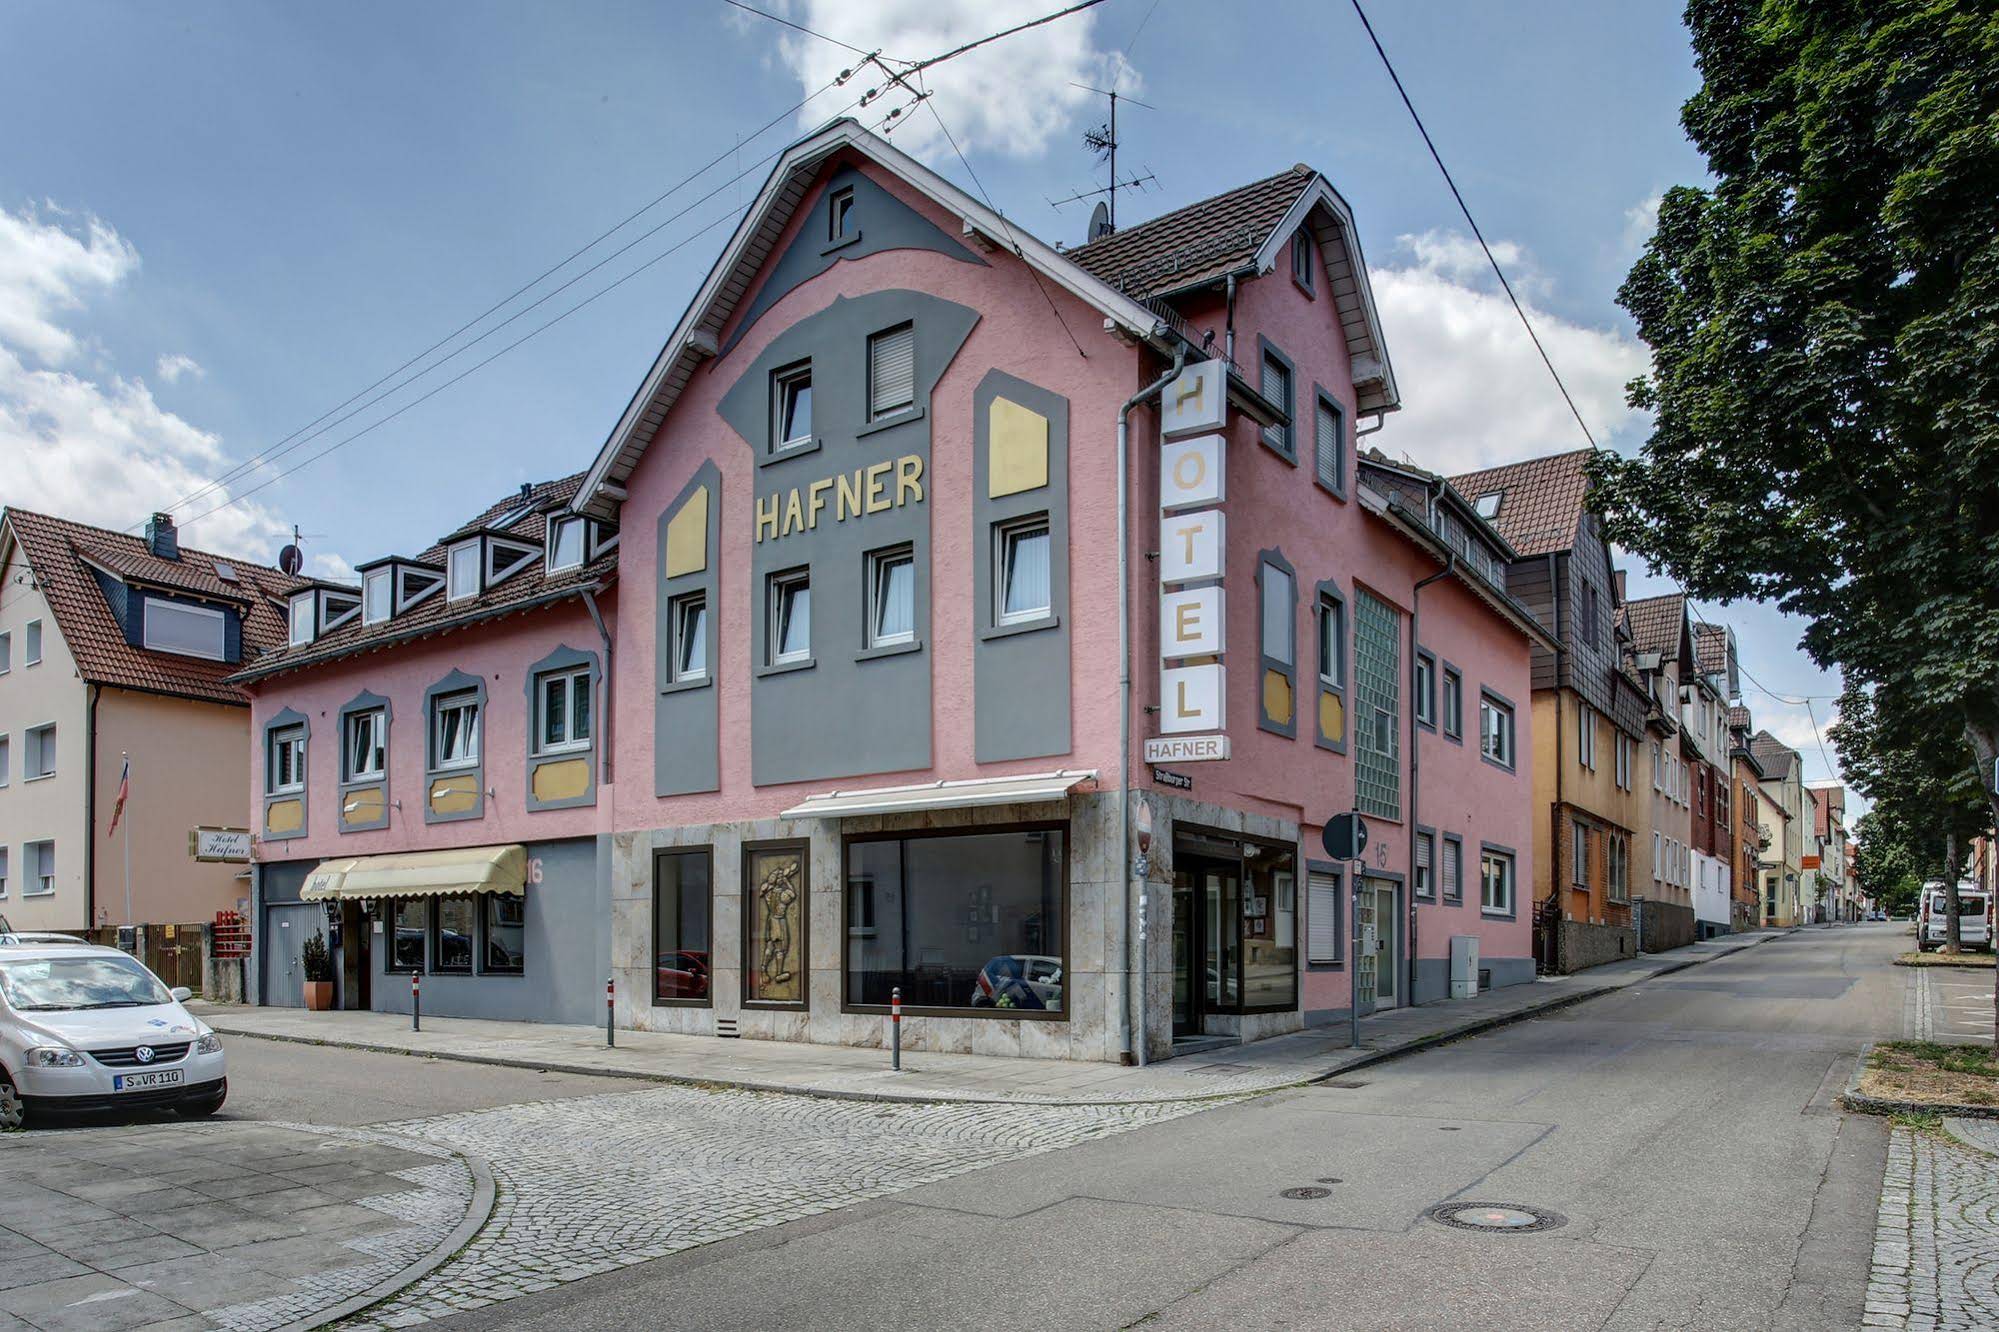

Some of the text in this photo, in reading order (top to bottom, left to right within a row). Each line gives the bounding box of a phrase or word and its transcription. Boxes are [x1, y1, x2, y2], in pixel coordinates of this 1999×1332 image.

[756, 454, 924, 544] HAFNER
[1173, 375, 1206, 718] HOTEL
[1149, 741, 1218, 758] HAFNER
[211, 834, 240, 844] Hotel
[205, 844, 245, 858] Hafner
[1376, 841, 1387, 868] 15
[126, 1071, 179, 1087] S VR 110
